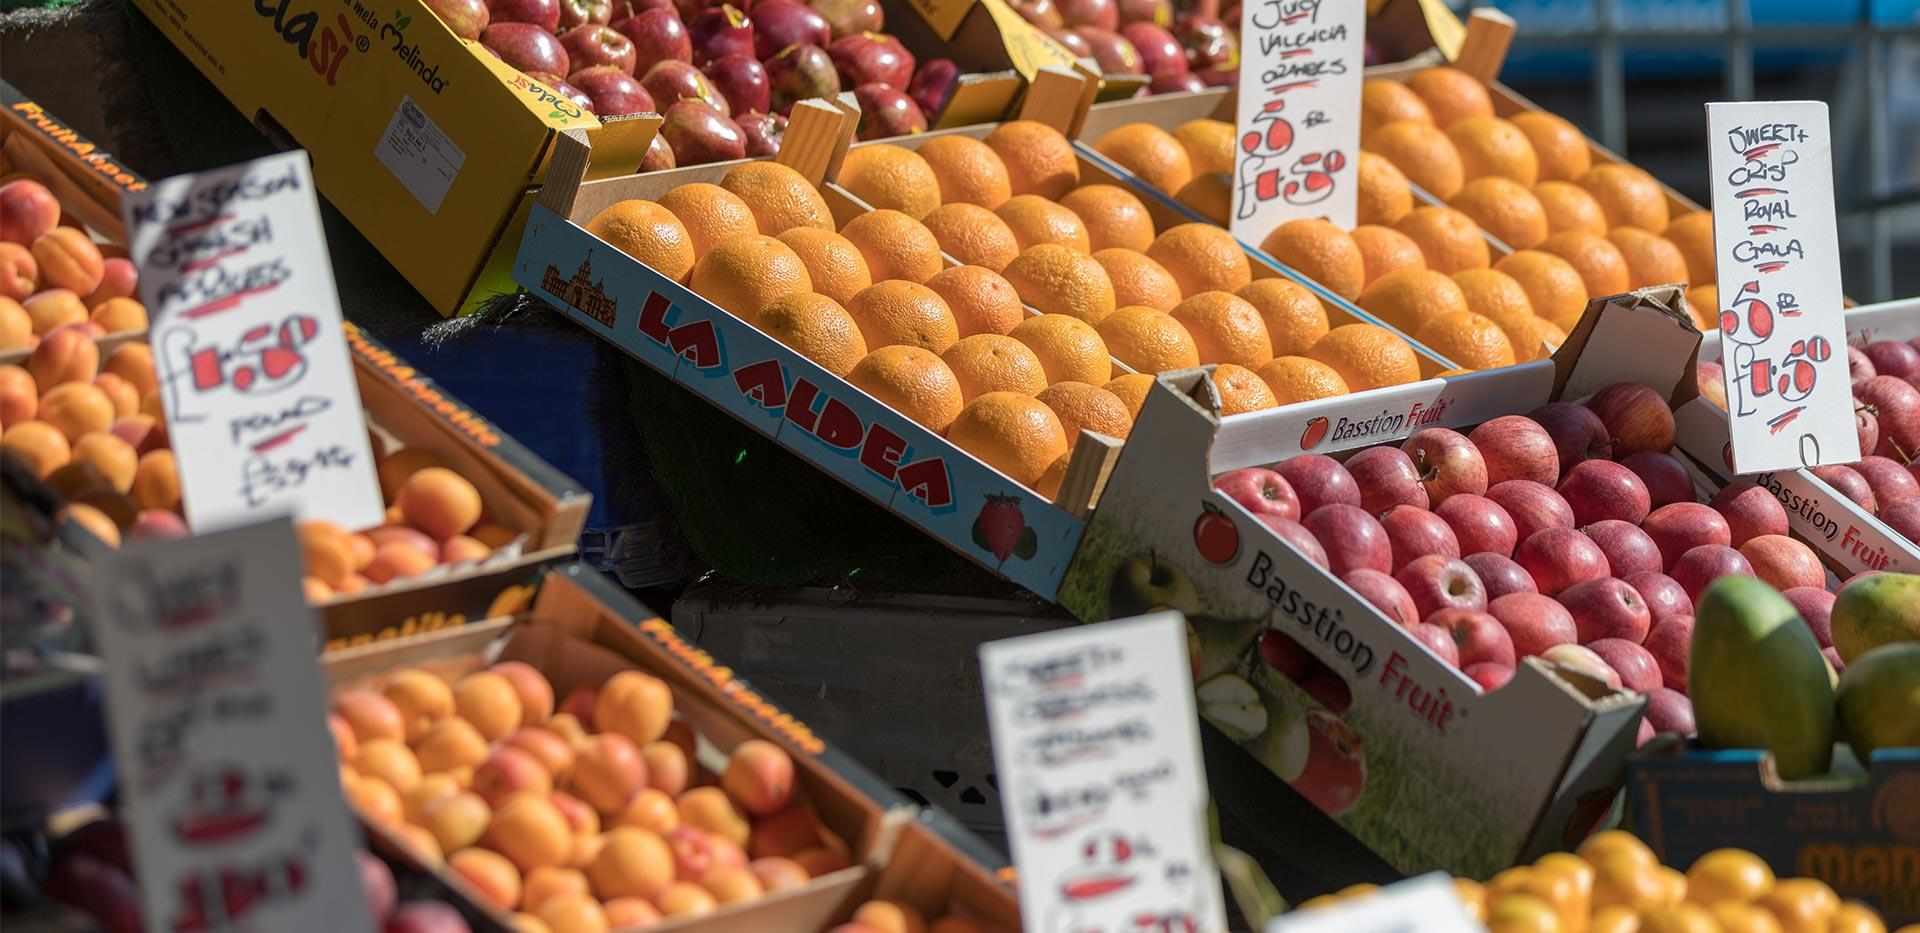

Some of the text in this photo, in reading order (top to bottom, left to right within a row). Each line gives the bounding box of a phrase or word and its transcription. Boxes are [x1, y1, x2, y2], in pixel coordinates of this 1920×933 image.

[380, 23, 442, 95] Melinda
[1259, 23, 1347, 56] VALENCIA
[1744, 199, 1798, 222] ROYAL
[1732, 239, 1804, 264] GALA
[637, 290, 954, 508] LA ALDEA
[1331, 400, 1448, 443] Basstion Fruit
[1756, 471, 1890, 571] Basstion Fruit
[1247, 551, 1454, 731] Basstion Fruit
